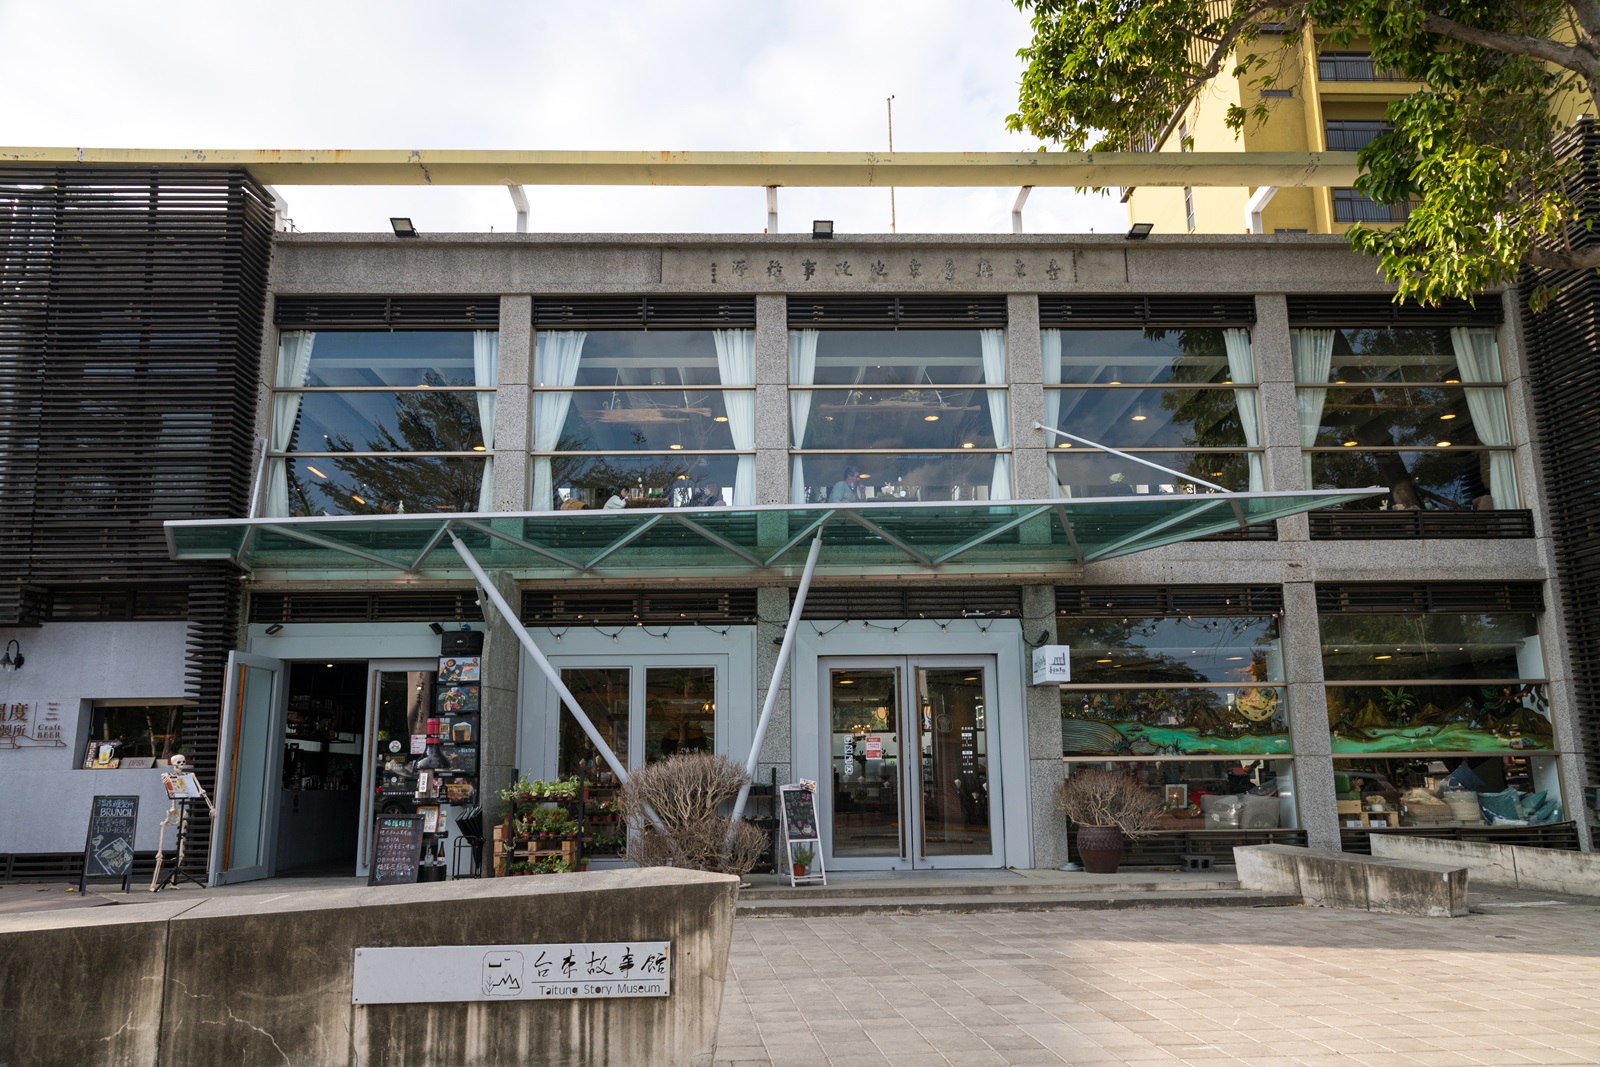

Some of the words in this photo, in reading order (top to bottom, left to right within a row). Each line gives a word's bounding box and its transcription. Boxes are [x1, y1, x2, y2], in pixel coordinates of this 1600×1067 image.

[85, 742, 97, 768] BEER
[100, 807, 132, 817] BRUNCH
[539, 985, 578, 996] Taitung
[584, 984, 613, 995] Story
[617, 983, 661, 993] Museum
